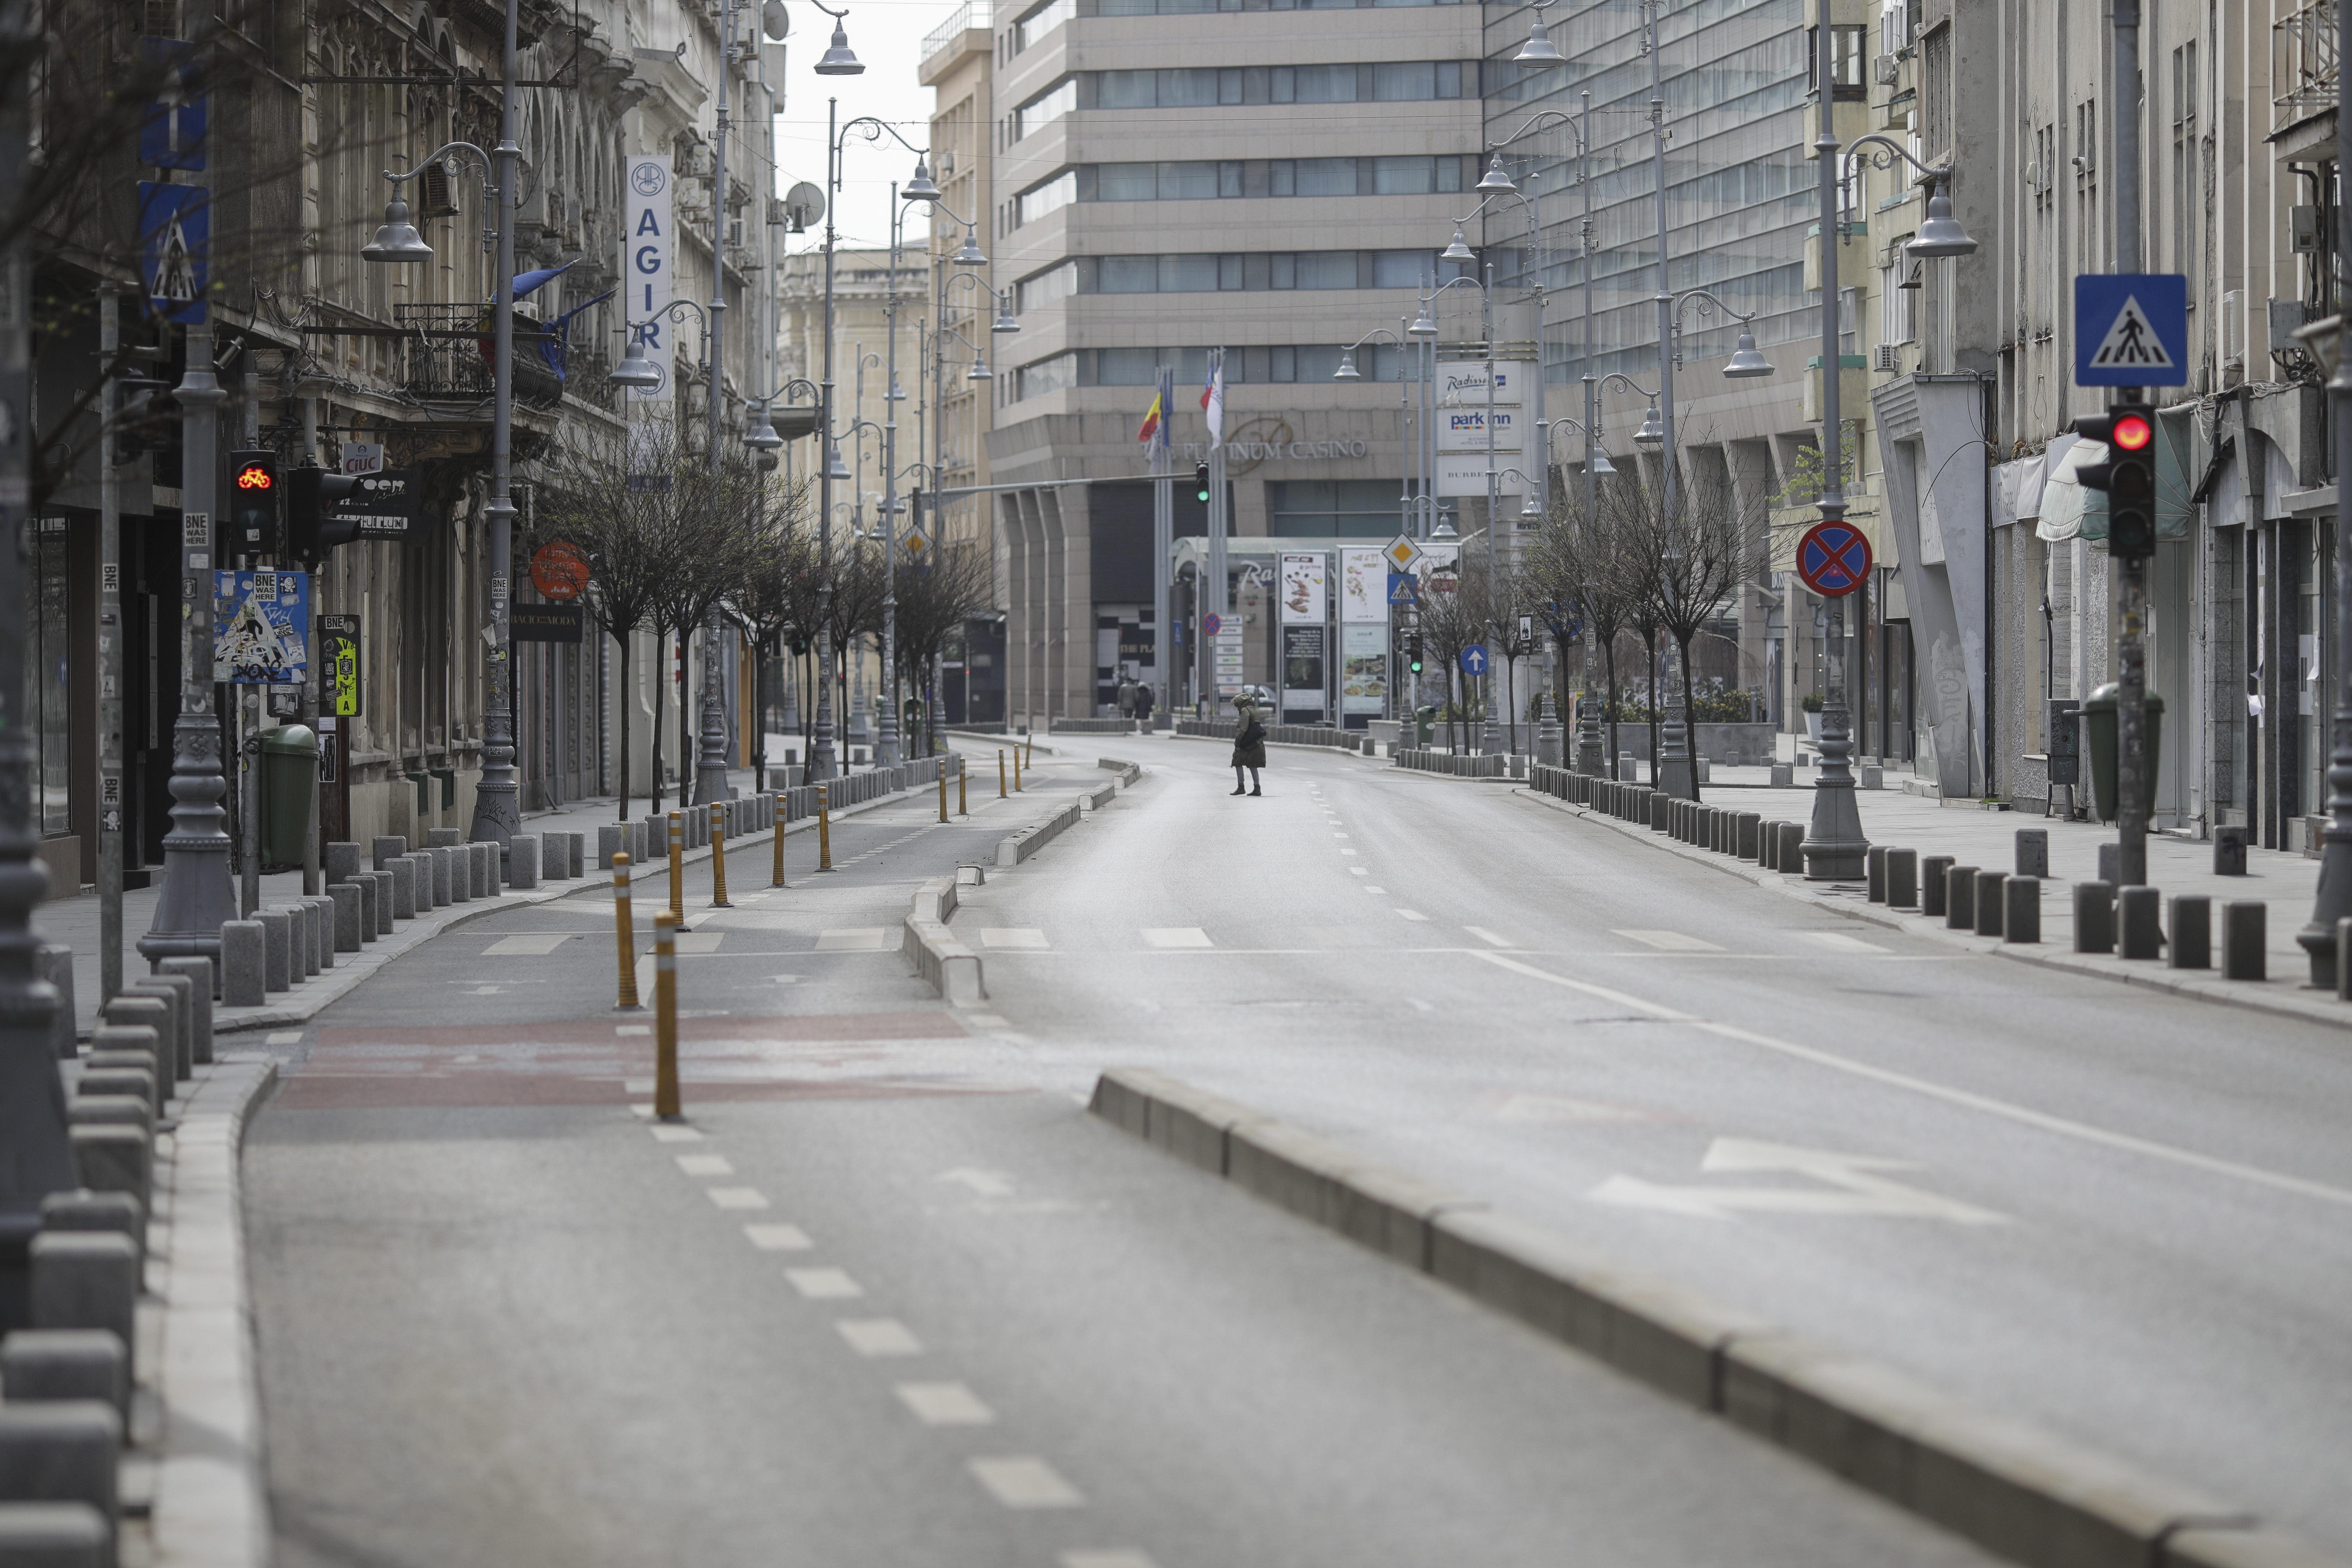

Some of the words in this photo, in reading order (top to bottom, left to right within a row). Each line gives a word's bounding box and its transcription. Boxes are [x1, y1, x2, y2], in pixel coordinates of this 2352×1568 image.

[636, 208, 661, 350] AGIR
[1448, 374, 1489, 391] Radisso
[1451, 412, 1484, 430] park
[1184, 442, 1282, 460] PLINUM
[1289, 440, 1367, 460] CASINO
[186, 515, 207, 528] BNE
[104, 566, 117, 589] BNE
[255, 575, 275, 586] BNE
[493, 579, 506, 588] BNE
[327, 617, 343, 628] BNE
[510, 615, 540, 624] BACIO
[547, 616, 576, 625] MODA
[104, 779, 117, 802] BNE
